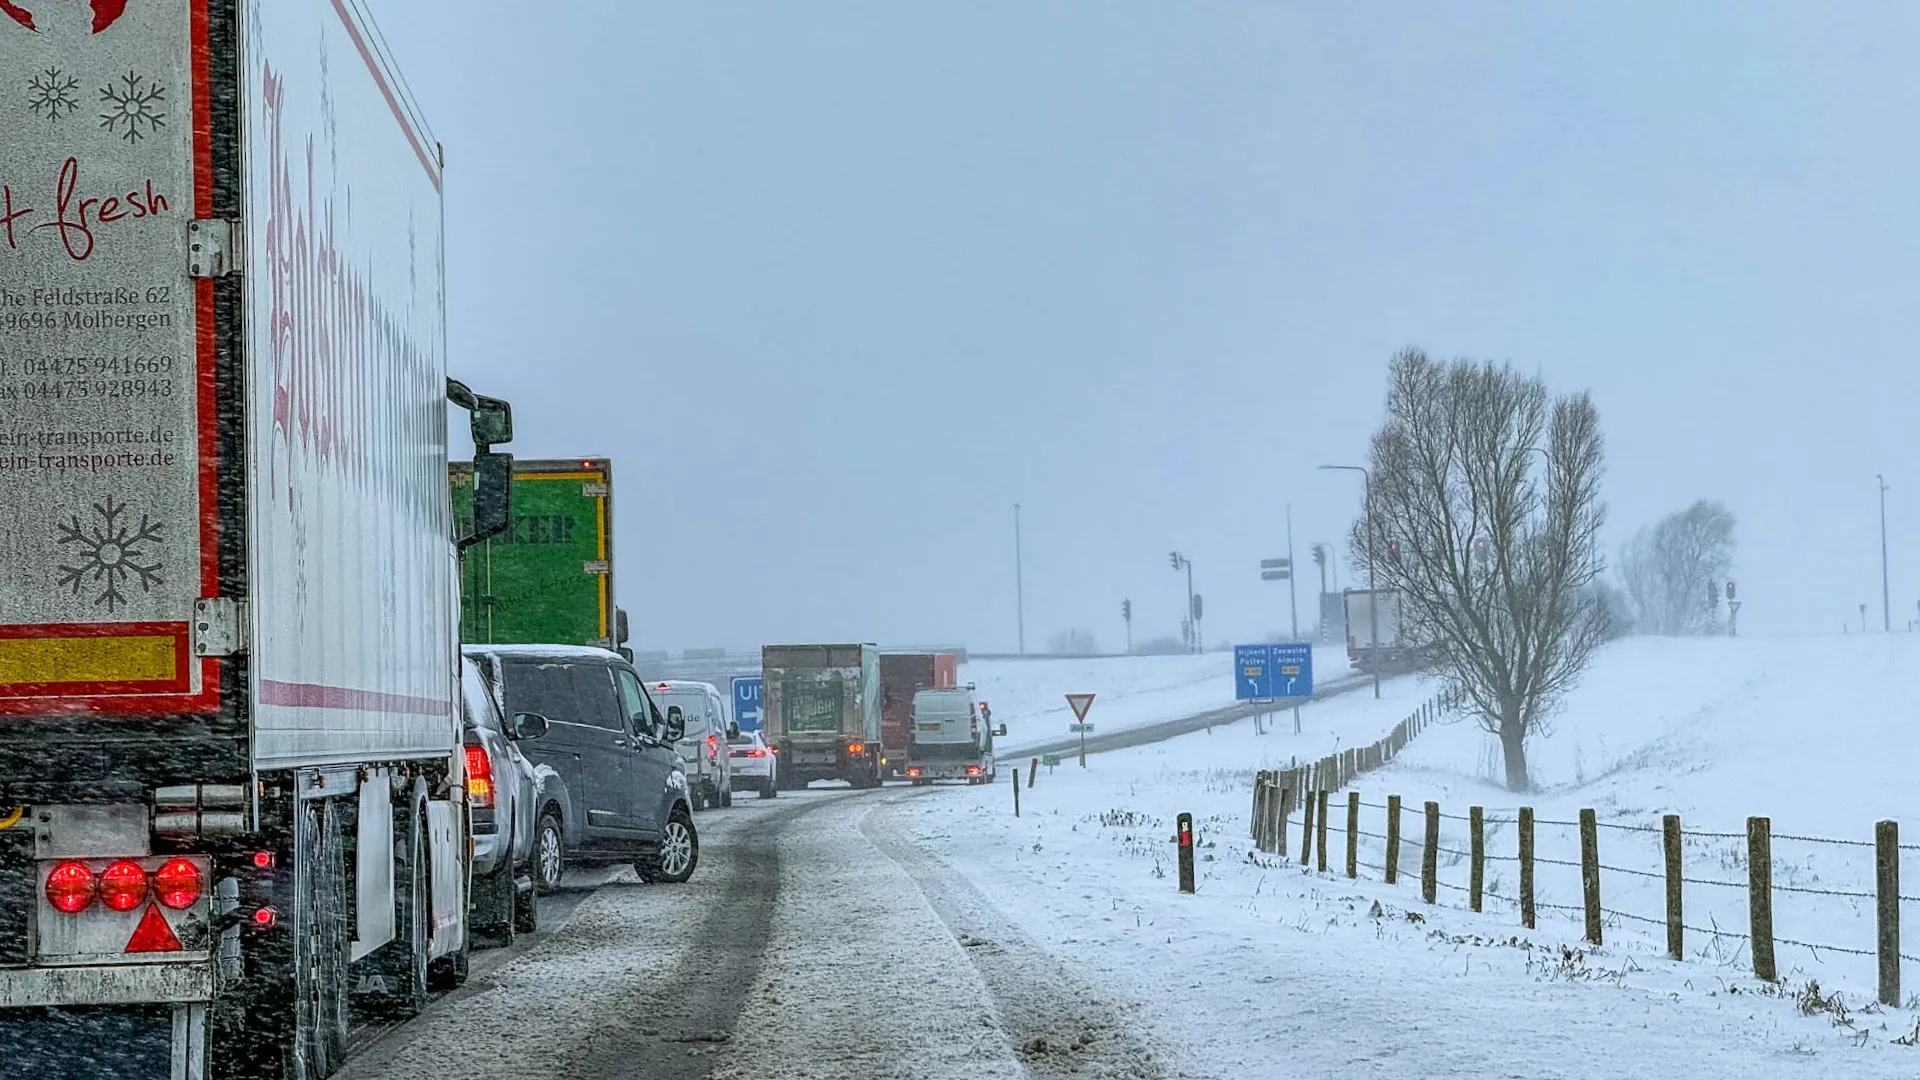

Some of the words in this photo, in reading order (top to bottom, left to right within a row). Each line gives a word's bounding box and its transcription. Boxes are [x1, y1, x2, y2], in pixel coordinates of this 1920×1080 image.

[27, 156, 168, 260] fresh
[33, 286, 139, 305] Feldstraße
[146, 286, 169, 303] 62
[0, 312, 56, 329] 9696
[64, 310, 170, 331] Molbergen
[23, 358, 87, 375] 04475
[94, 356, 172, 374] 941669
[24, 382, 88, 399] 04475
[95, 379, 172, 397] 928943
